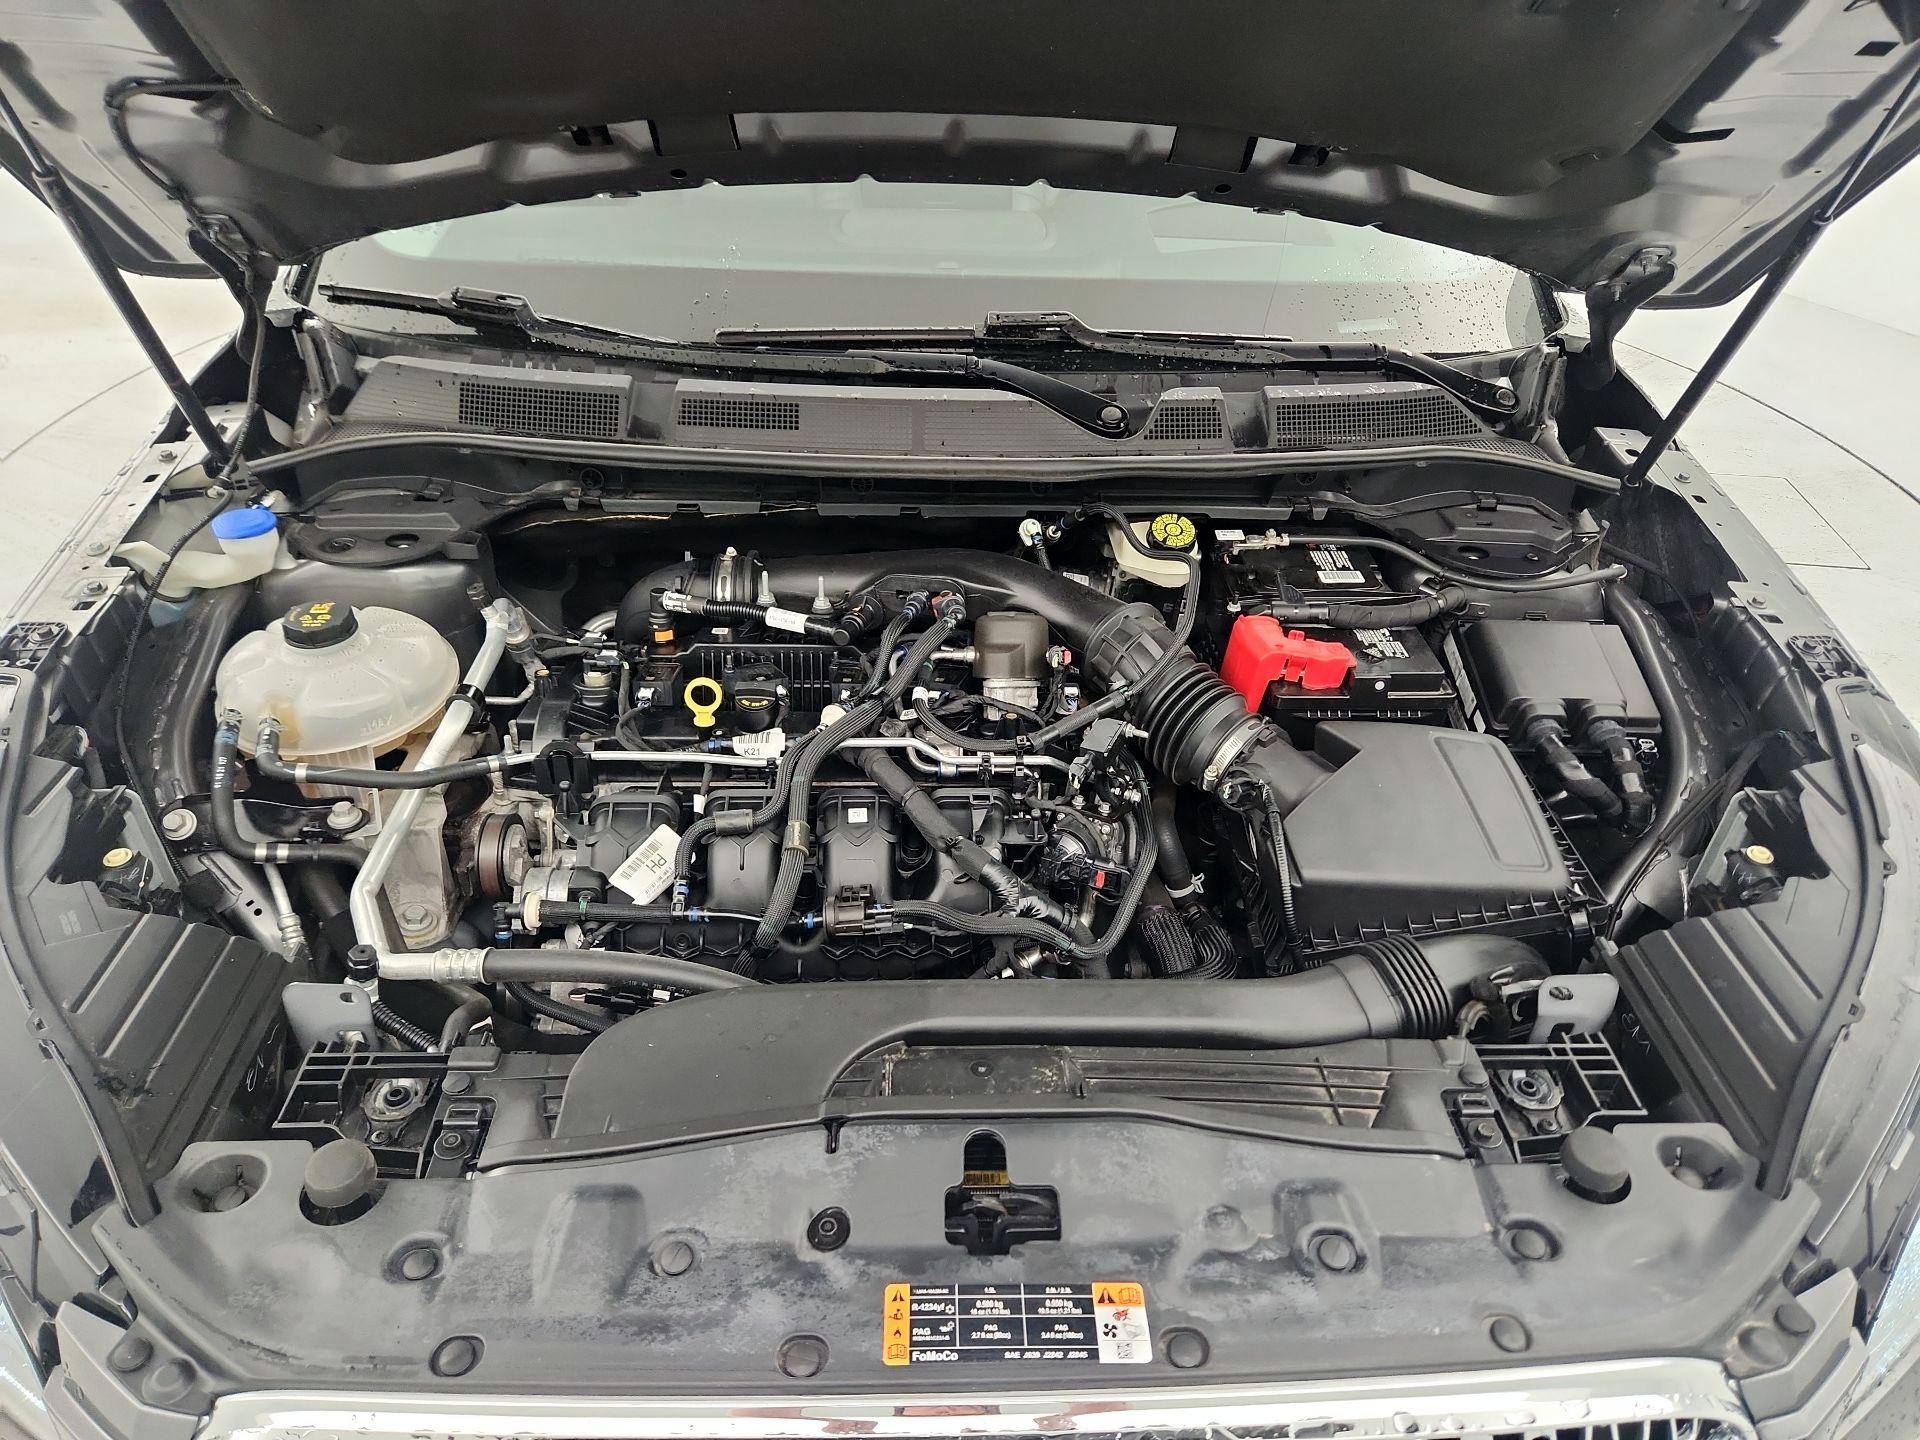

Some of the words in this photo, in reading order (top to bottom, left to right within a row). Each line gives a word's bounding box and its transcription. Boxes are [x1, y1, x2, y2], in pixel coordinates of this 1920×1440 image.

[743, 748, 761, 756] K21
[646, 853, 668, 874] PH
[911, 1302, 945, 1312] R-1234yf
[912, 1327, 931, 1335] PAG
[911, 1350, 959, 1362] FoMoCo
[1004, 1351, 1021, 1359] SAE
